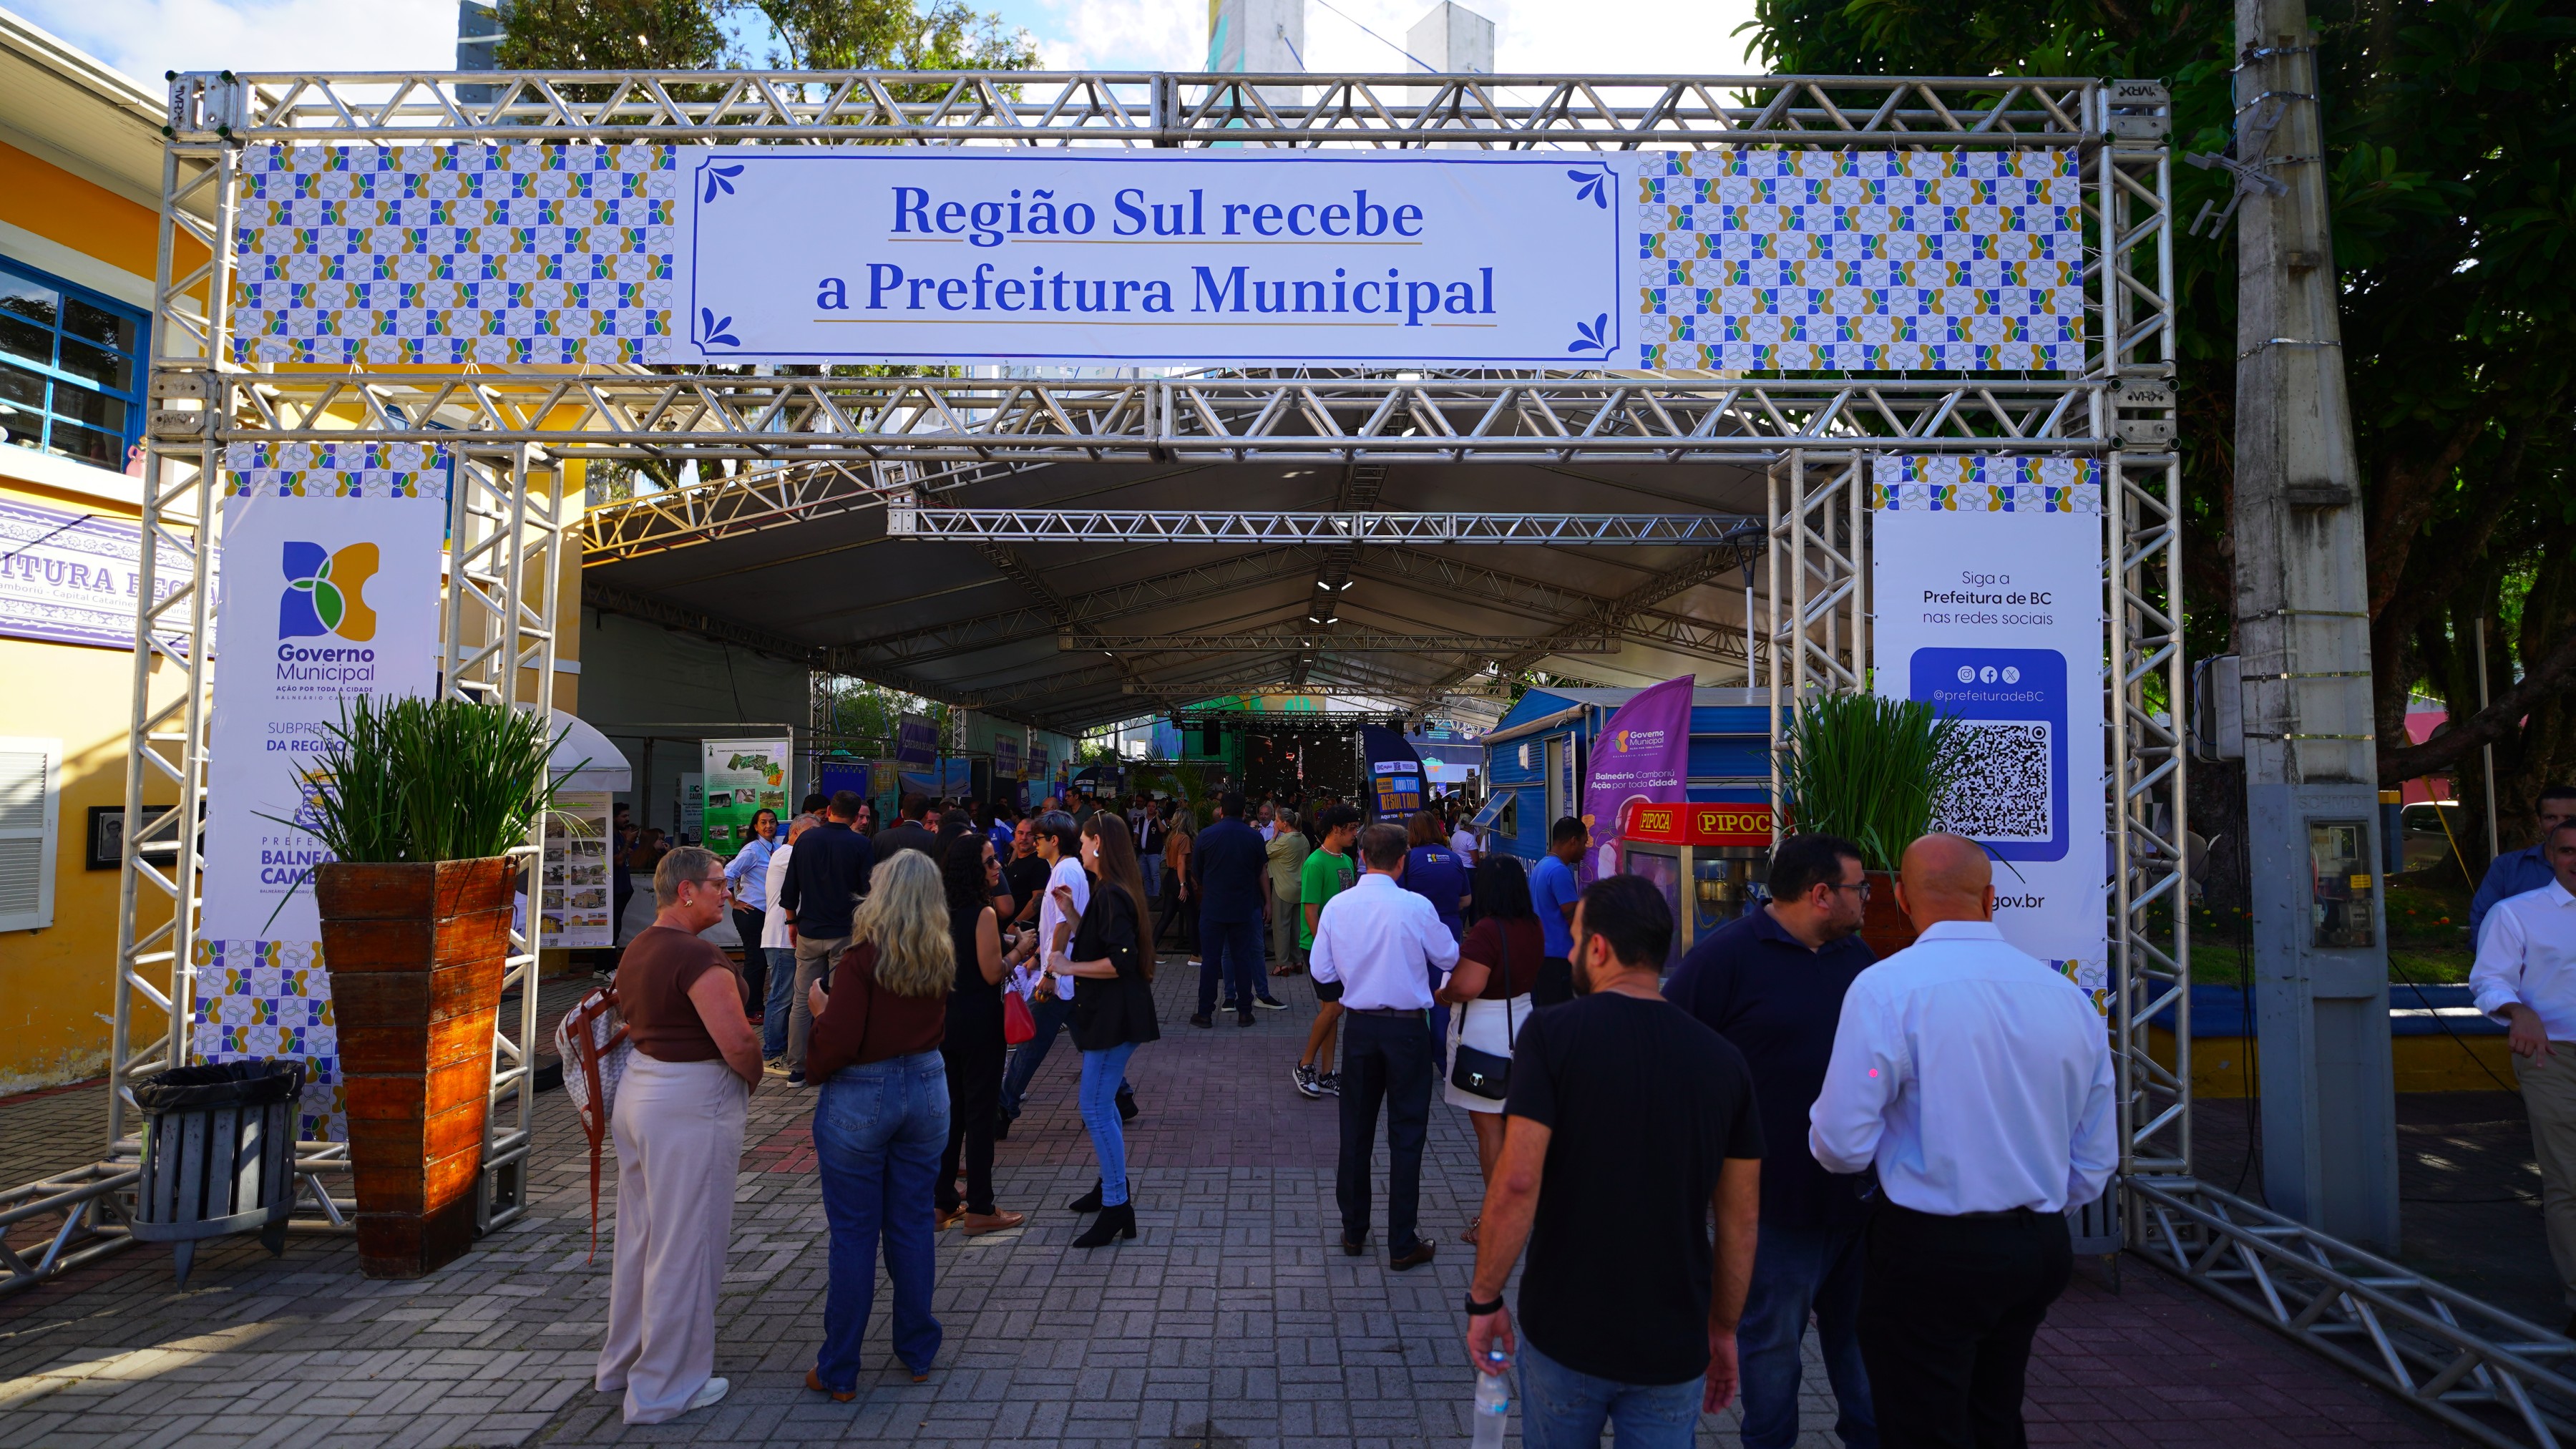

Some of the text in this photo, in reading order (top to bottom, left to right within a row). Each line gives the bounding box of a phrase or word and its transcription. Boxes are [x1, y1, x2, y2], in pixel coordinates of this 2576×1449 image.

[890, 186, 1423, 248] Região Sul recebe
[816, 263, 1497, 327] a Prefeitura Municipal
[0, 550, 116, 594] ITURA
[1962, 571, 2010, 587] Siga a
[53, 590, 89, 602] Capital
[1923, 590, 2052, 605] Prefeitura de BC
[1923, 611, 2054, 625] nas redes sociais
[278, 643, 375, 663] Governo
[276, 663, 375, 685] Municipal
[1933, 689, 2045, 702] @prefeituradeBC
[268, 722, 356, 734] SUBPREFEITU
[1629, 730, 1664, 738] Governo
[266, 740, 287, 751] DA
[291, 738, 346, 751] REGIÃO
[1629, 736, 1664, 746] Municipal
[1636, 769, 1675, 779] Camboriú
[1395, 779, 1407, 791] AQUI
[1591, 781, 1611, 791] Ação
[1648, 779, 1678, 787] Cidade
[1380, 793, 1420, 811] RESULTADO
[1641, 812, 1772, 832] PIPOCA PIPOC
[262, 836, 322, 846] PREFEI
[260, 867, 316, 885] CAMB
